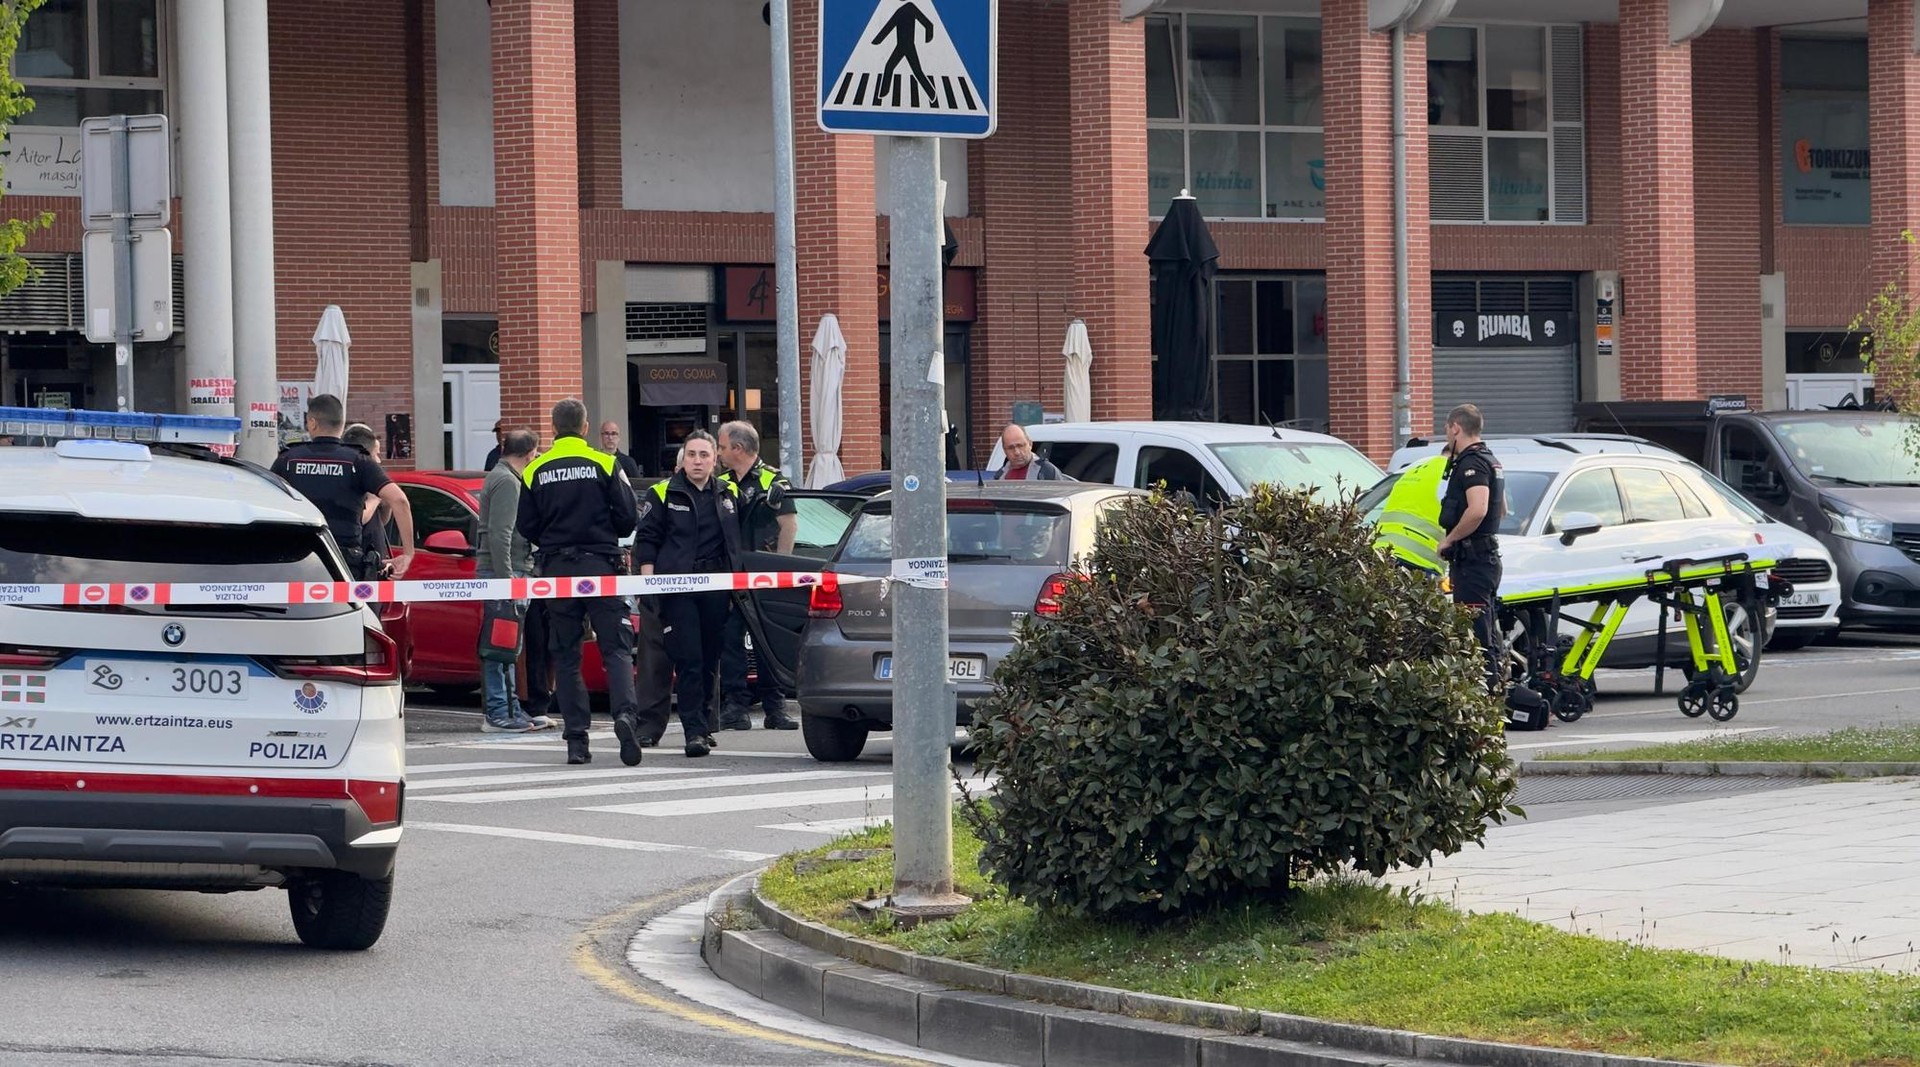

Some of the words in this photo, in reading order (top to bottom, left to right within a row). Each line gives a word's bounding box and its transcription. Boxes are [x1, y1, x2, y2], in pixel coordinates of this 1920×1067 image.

[15, 146, 52, 166] Aitor
[40, 169, 82, 189] masaj
[1478, 315, 1532, 341] RUMBA
[650, 368, 679, 379] GOXO
[683, 368, 717, 379] GOXUA
[295, 463, 344, 475] ERTZAINTZA
[538, 466, 598, 485] UDALTZAINGOA
[422, 581, 488, 590] UDALTZAINGOA
[644, 575, 710, 586] UDALTZAINGOA
[199, 584, 265, 592] UDALTZAINGOA
[215, 593, 248, 601] POLIZIA
[172, 668, 242, 695] 3003
[0, 716, 37, 728] X1
[96, 715, 233, 729] www.ertzaintza.eus
[249, 742, 327, 760] POLIZIA
